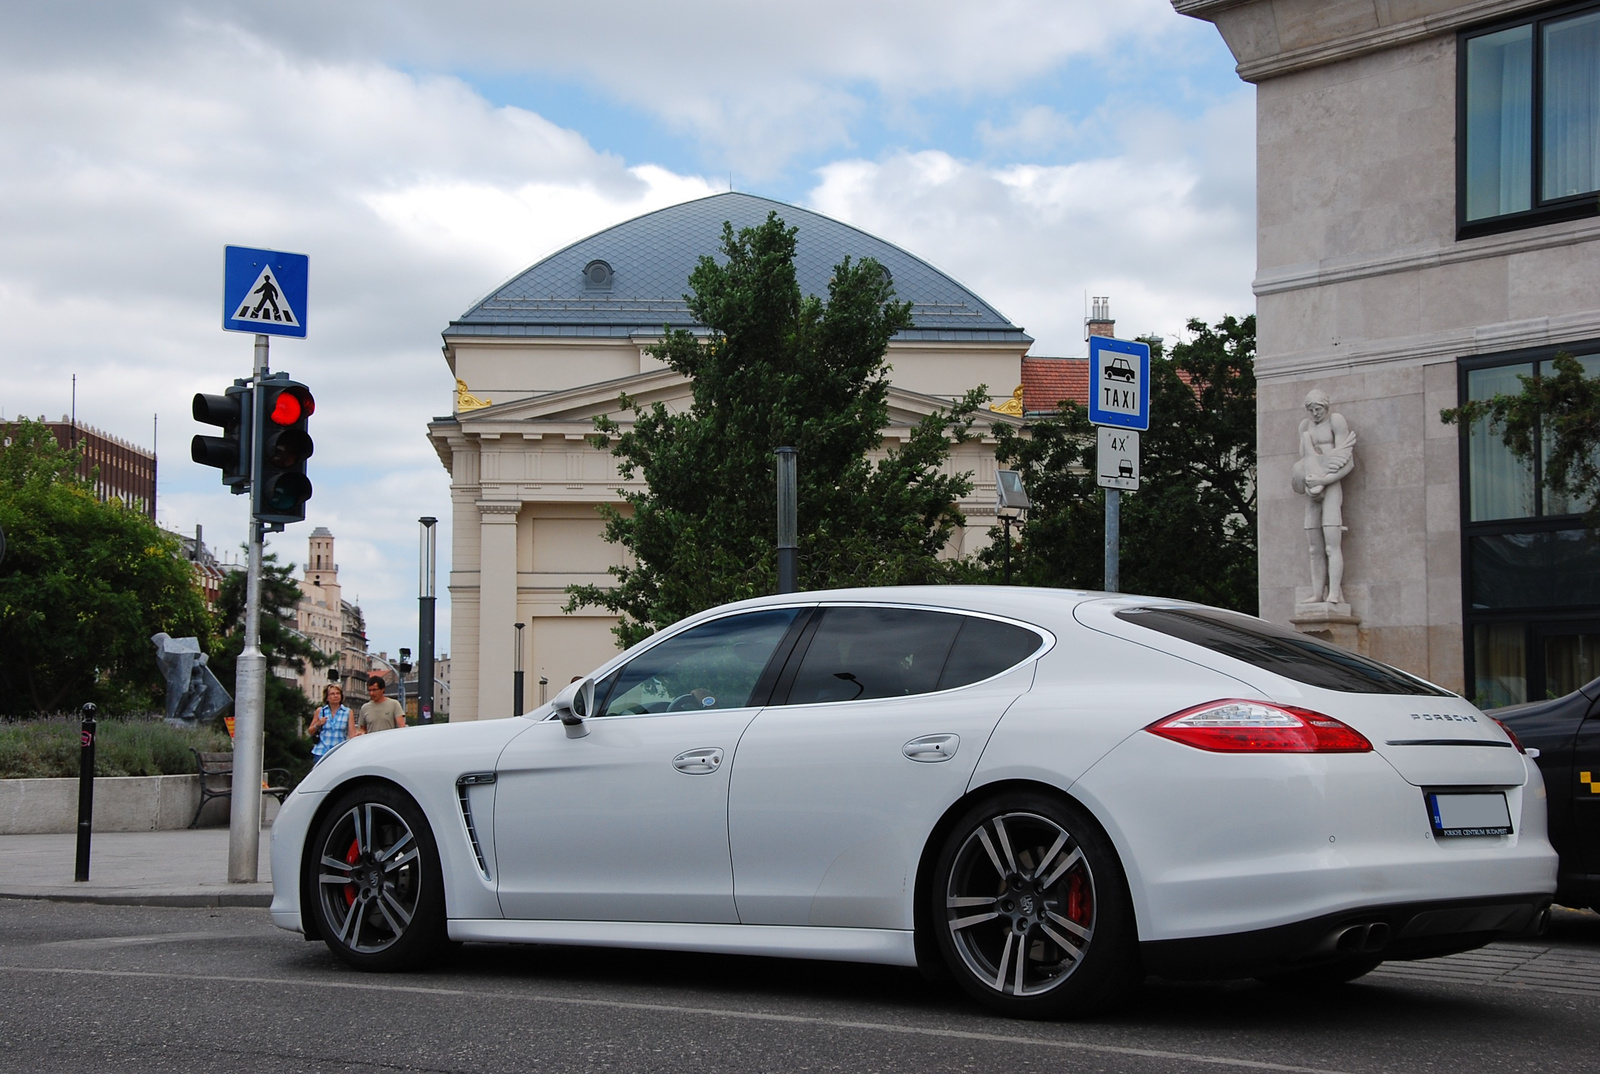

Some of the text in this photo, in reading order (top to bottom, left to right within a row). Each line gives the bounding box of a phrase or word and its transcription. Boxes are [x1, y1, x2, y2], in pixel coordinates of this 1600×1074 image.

[1104, 387, 1135, 410] TAXI
[1111, 437, 1126, 452] 4X
[1410, 714, 1478, 722] PORSCHE
